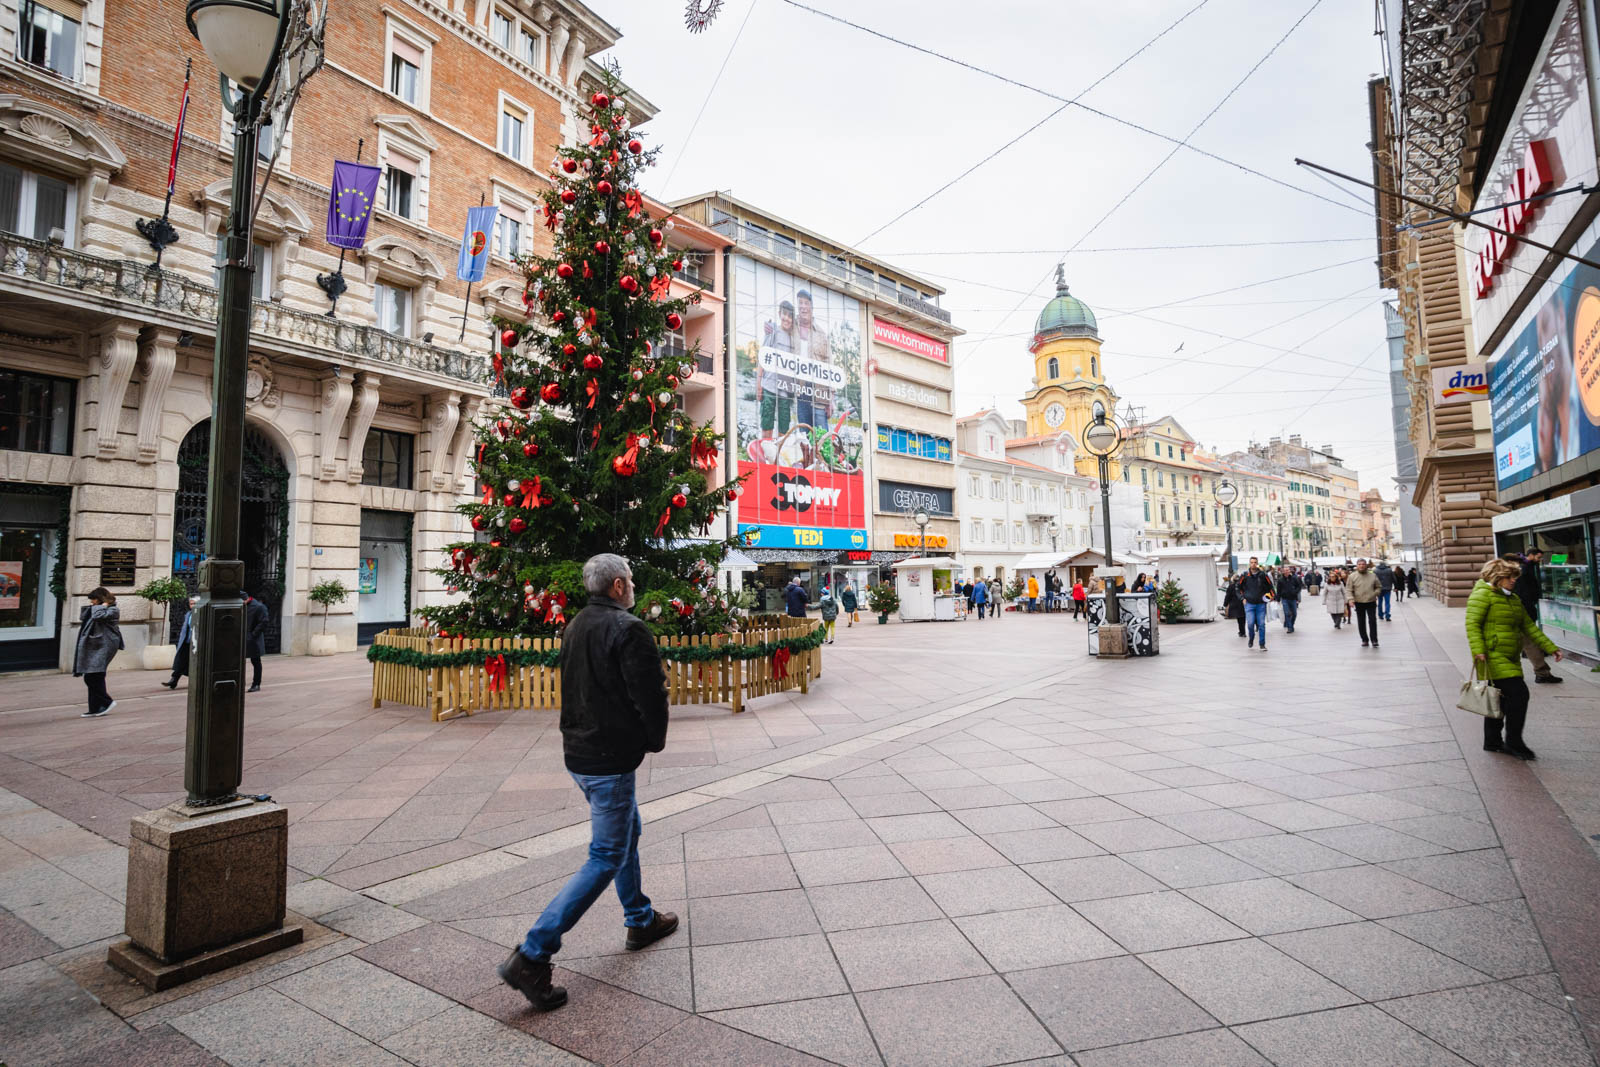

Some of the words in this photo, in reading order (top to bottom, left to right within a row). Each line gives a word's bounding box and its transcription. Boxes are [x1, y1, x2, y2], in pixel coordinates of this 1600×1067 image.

[1472, 141, 1549, 297] ROBNA
[874, 325, 945, 357] www.tommy.hr
[763, 352, 842, 384] #TvojeMisto
[1448, 370, 1483, 388] dm
[776, 379, 788, 391] ZA
[790, 382, 832, 401] TRADCIJU
[888, 382, 907, 398] naš
[918, 388, 937, 406] dom
[784, 482, 842, 507] TOMMY
[893, 488, 940, 512] CENTRA
[792, 529, 824, 546] TEDi
